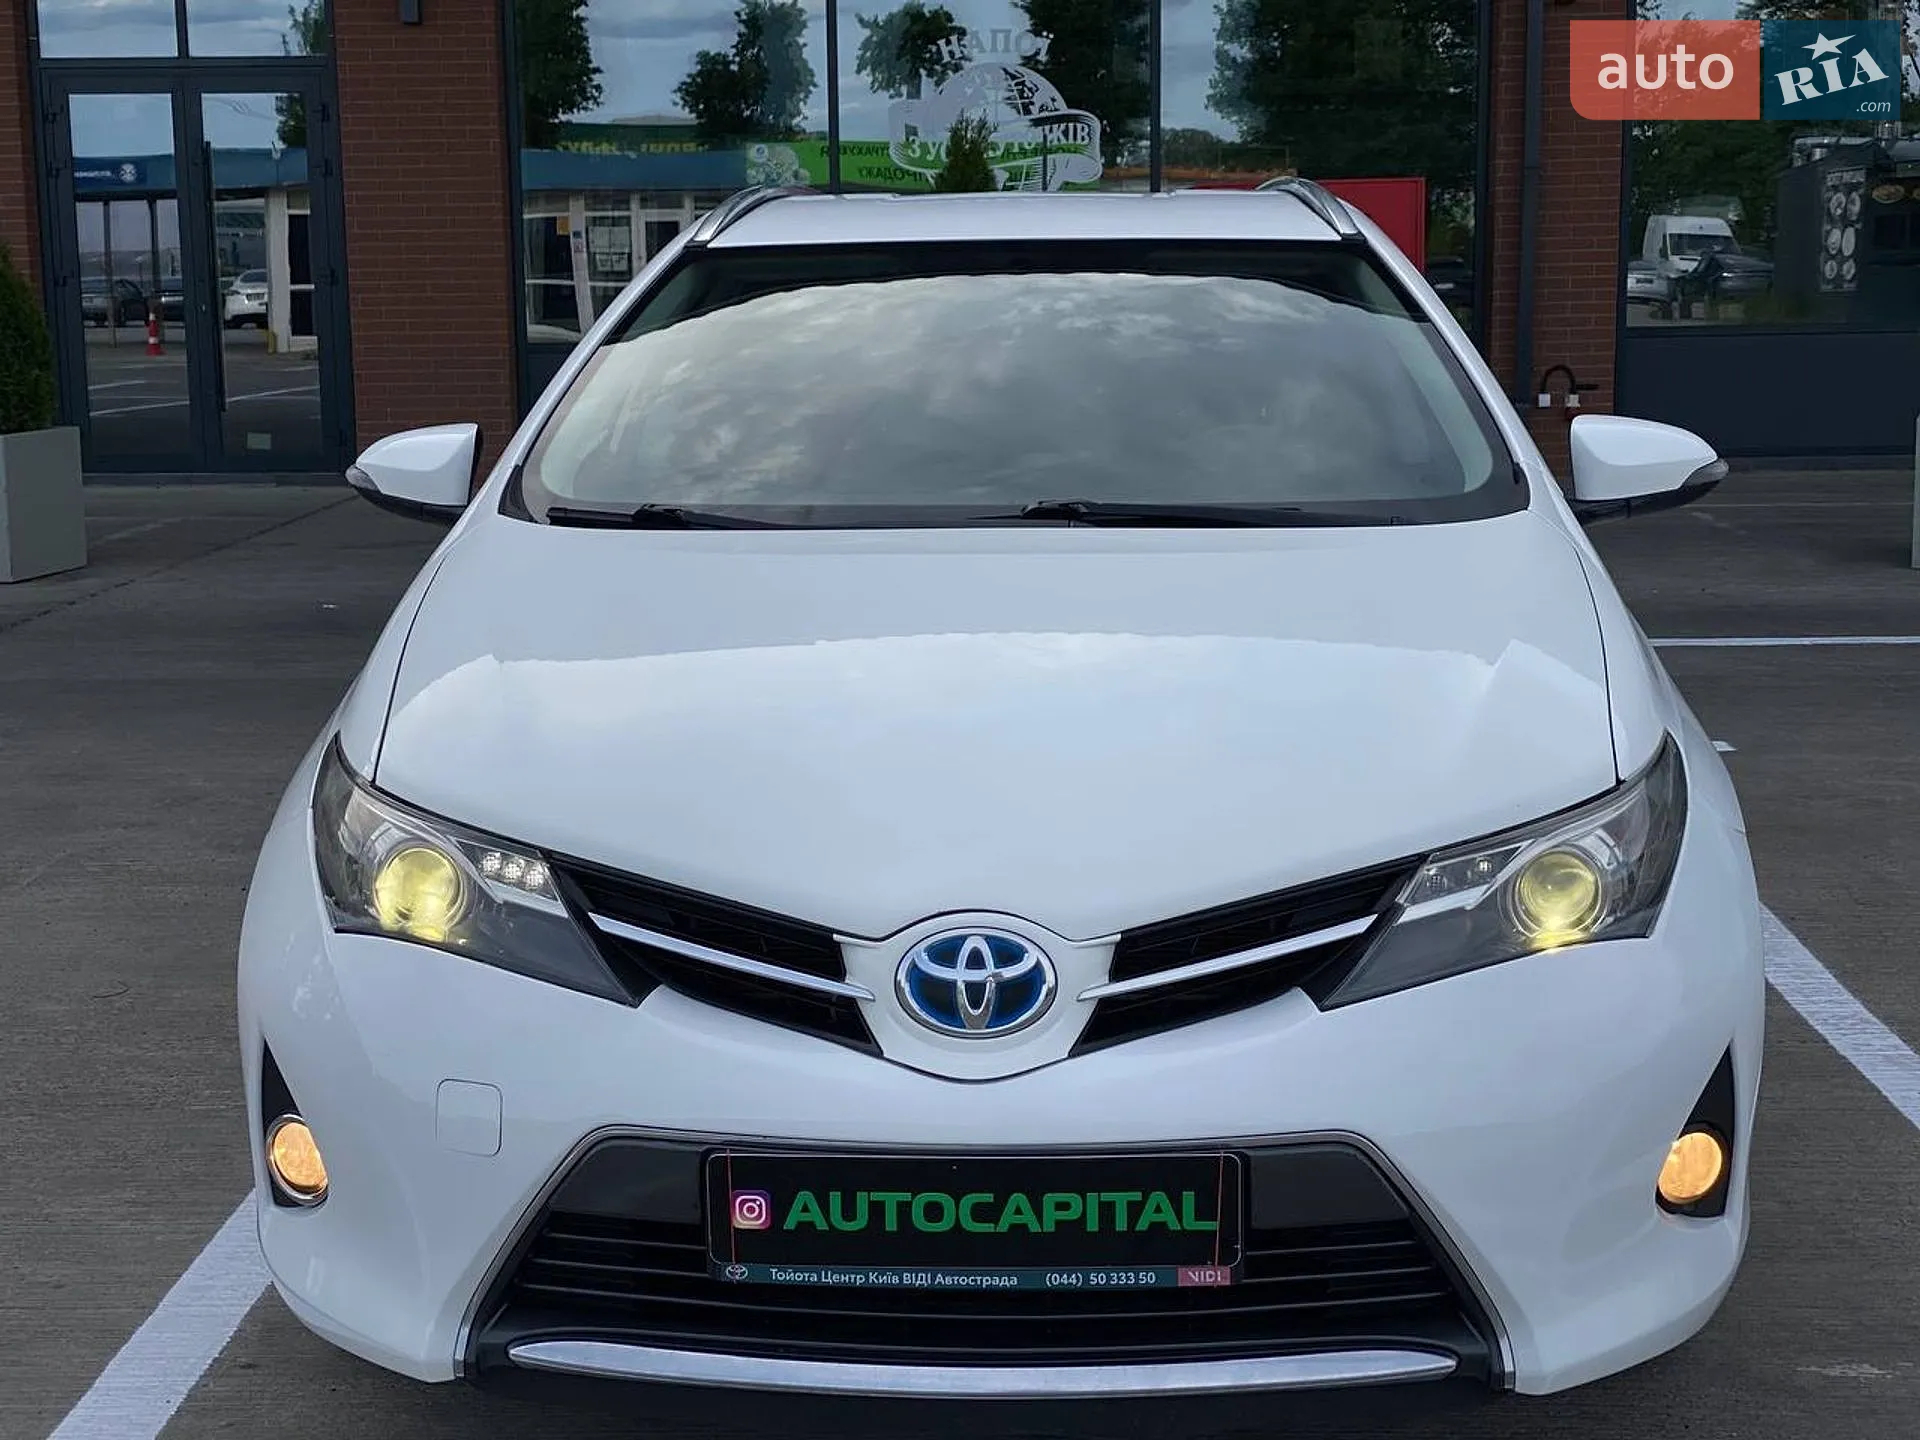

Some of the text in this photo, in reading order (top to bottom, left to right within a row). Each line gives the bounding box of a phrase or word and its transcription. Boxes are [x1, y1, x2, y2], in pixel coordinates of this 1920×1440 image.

[783, 1190, 1217, 1232] AUTOCAPITAL
[769, 1267, 1019, 1288] Тойота Центр Київ ВІДІ Автострада
[1045, 1271, 1156, 1287] (044) 50 333 50
